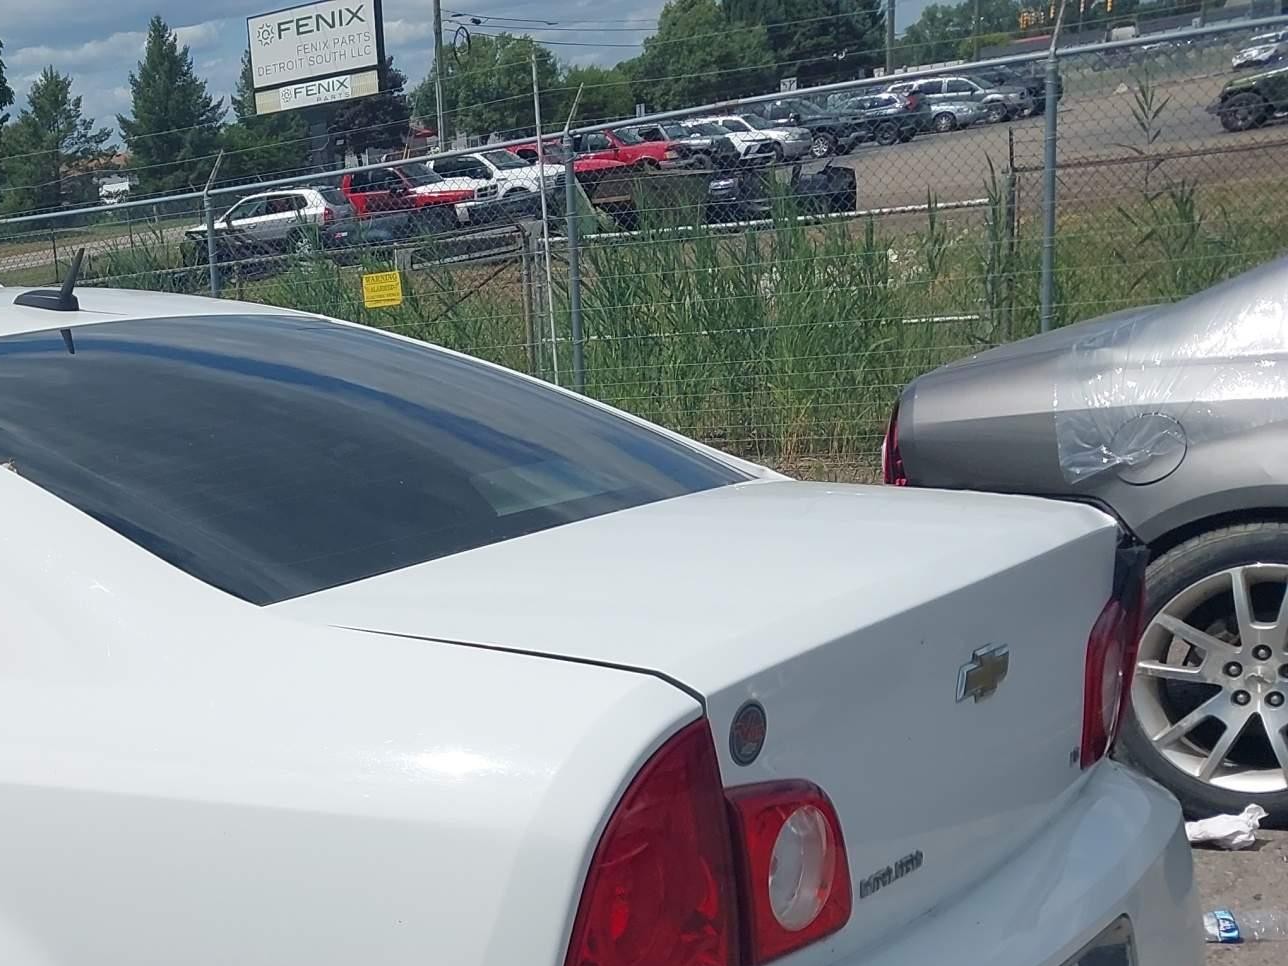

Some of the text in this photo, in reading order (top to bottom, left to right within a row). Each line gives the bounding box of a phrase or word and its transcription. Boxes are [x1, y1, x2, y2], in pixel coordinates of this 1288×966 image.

[277, 4, 366, 40] FENIX
[296, 31, 371, 57] FENIX PARTS
[257, 44, 372, 77] DETROIT SOUTH LLC
[293, 77, 350, 100] FENIX
[316, 91, 351, 103] PARTS
